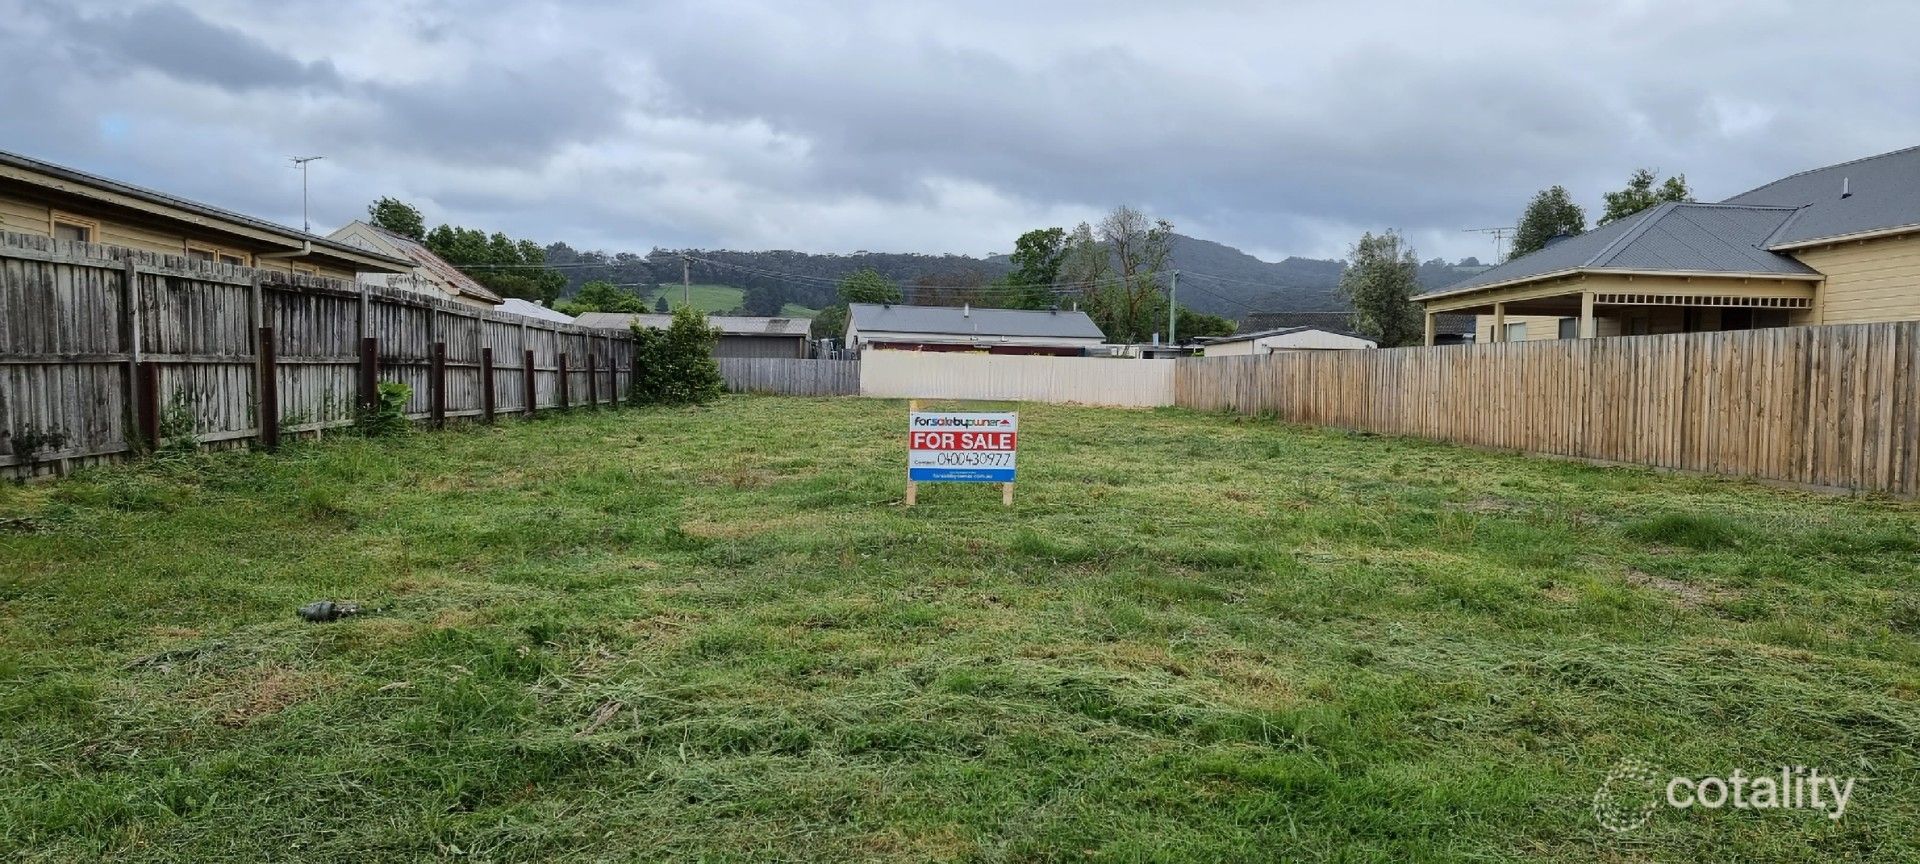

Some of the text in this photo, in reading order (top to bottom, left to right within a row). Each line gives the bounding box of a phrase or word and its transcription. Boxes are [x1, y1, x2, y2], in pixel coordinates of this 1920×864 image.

[914, 432, 1012, 450] FOR SALE
[937, 452, 1011, 466] 0400430977
